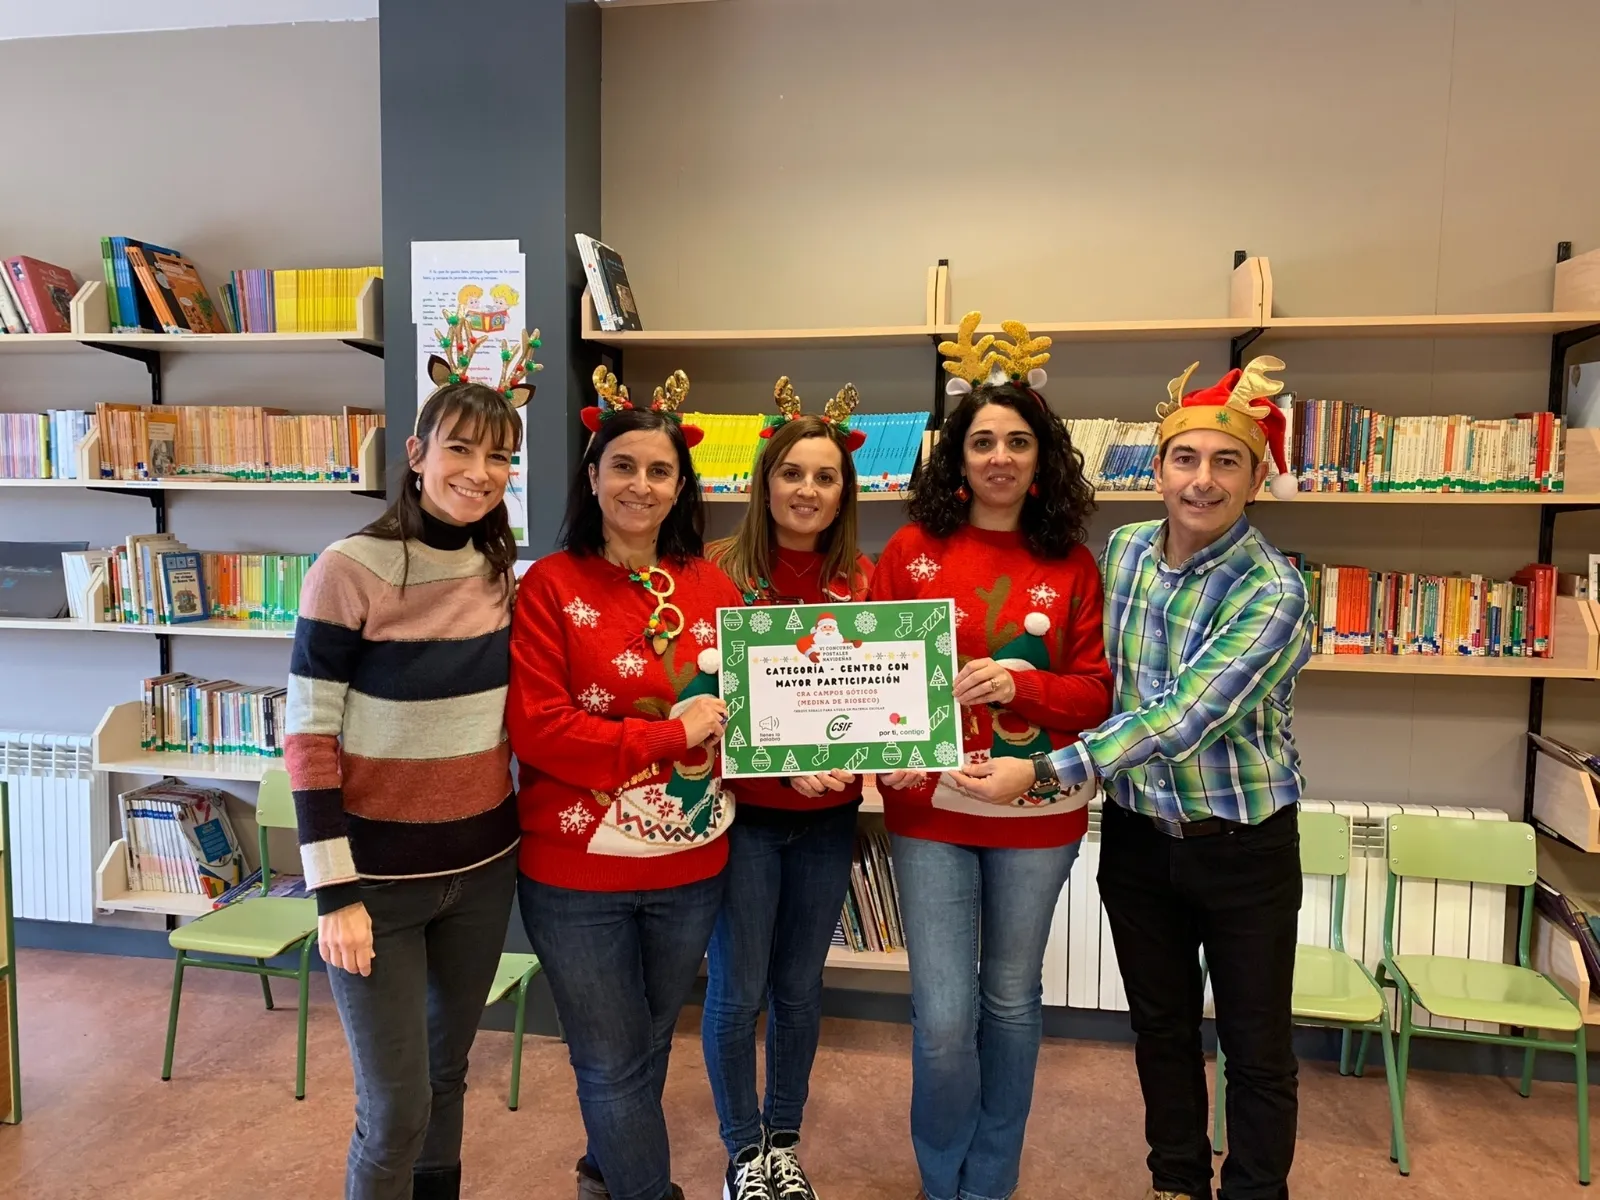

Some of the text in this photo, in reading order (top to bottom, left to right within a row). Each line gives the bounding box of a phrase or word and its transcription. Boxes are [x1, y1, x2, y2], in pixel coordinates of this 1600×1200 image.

[766, 663, 825, 675] CATEGORÍA
[840, 663, 882, 673] CENTRO
[888, 663, 909, 671] CON
[776, 673, 900, 688] MAYOR PARTICIPACIÓN
[797, 699, 830, 707] (MEDINA
[831, 722, 853, 732] CSIF
